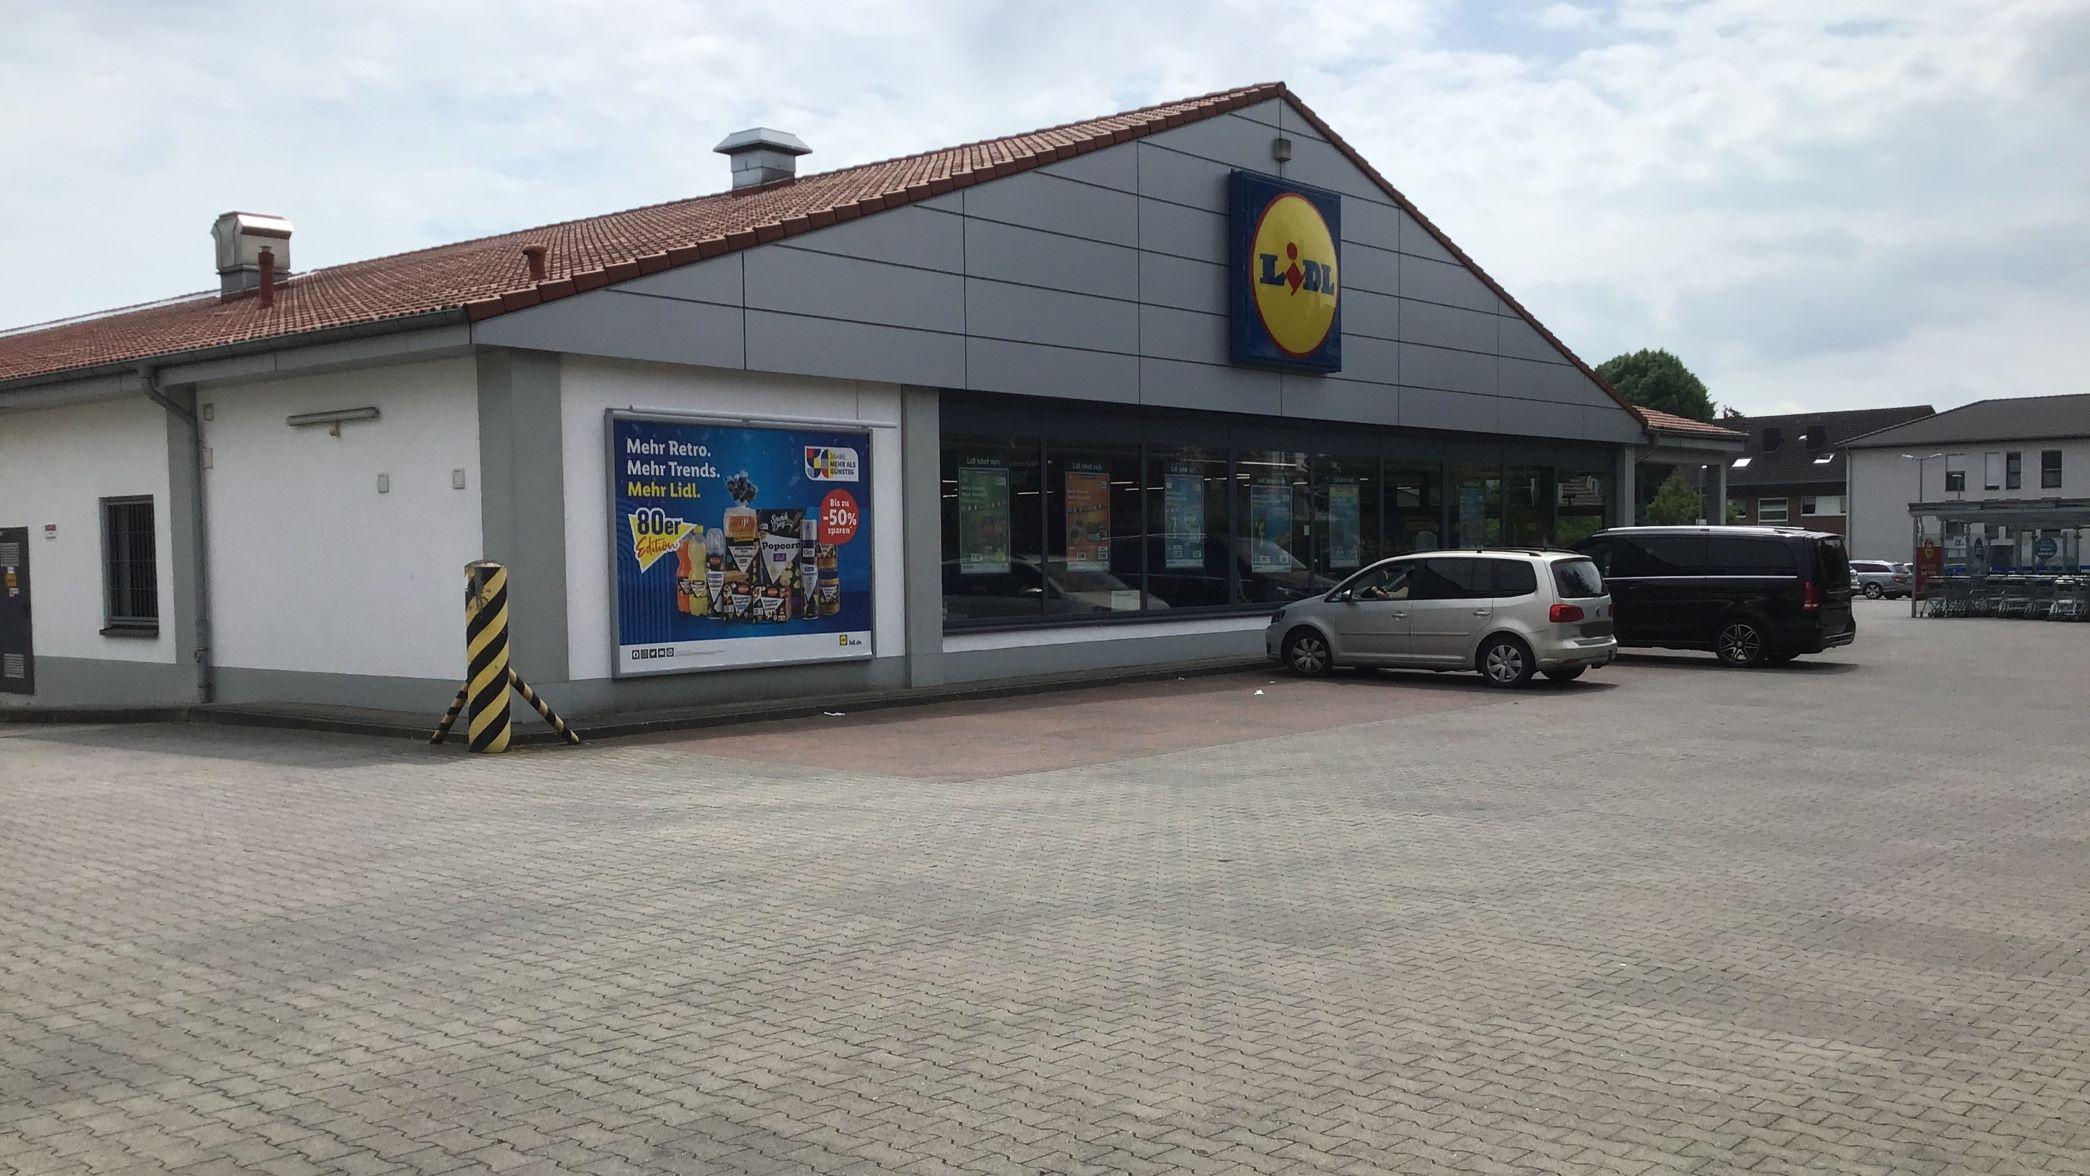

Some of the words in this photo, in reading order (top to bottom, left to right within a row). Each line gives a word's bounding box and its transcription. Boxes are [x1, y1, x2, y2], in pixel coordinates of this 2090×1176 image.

[1259, 242, 1335, 296] LIDL
[626, 438, 666, 455] Mehr
[668, 440, 711, 457] Retro.
[627, 460, 666, 477] Mehr
[668, 461, 720, 478] Trends.
[628, 481, 667, 497] Mehr
[670, 482, 701, 498] Lidl.
[830, 498, 840, 507] Bis
[637, 509, 681, 535] 80er
[823, 509, 857, 526] -50%
[636, 536, 678, 558] Edition
[762, 541, 800, 552] Popcorn
